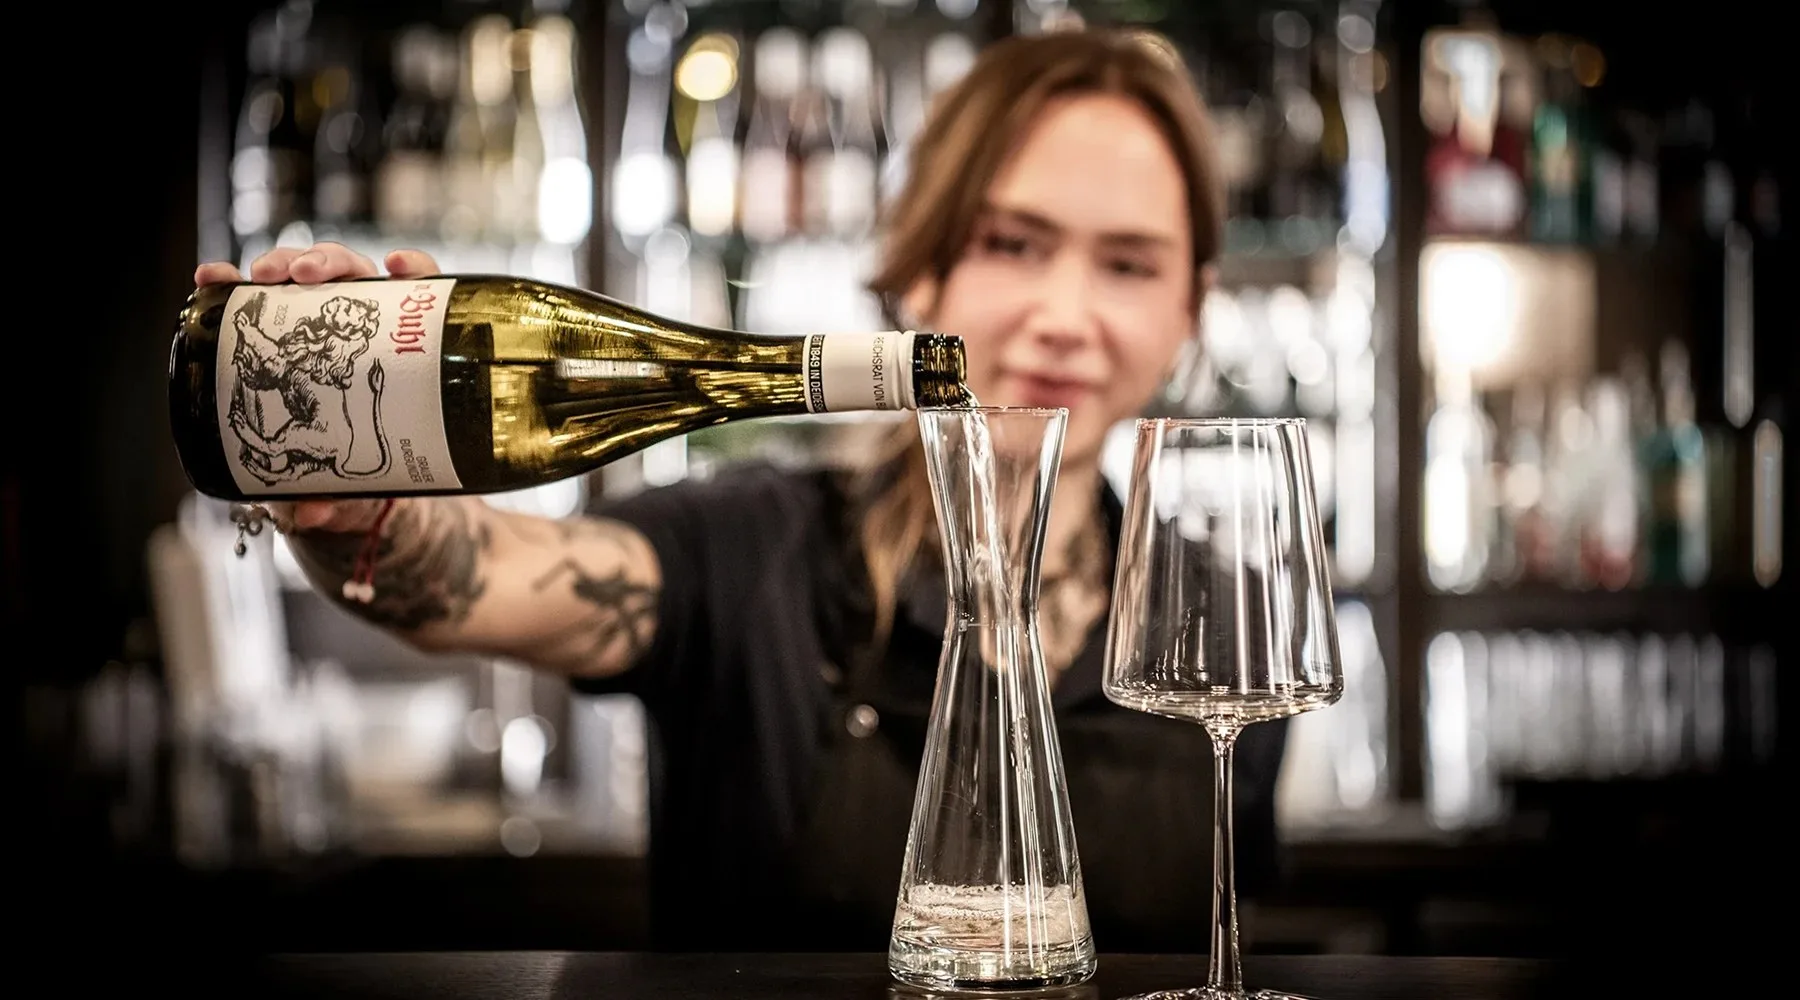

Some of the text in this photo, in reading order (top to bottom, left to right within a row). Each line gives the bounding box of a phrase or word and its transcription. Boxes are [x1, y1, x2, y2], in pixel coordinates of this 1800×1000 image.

[273, 304, 288, 326] 2023
[390, 293, 437, 355] Buhl
[810, 346, 821, 367] 1849
[872, 336, 885, 382] REICHSRAT
[810, 369, 820, 379] IN
[873, 383, 885, 402] VON
[400, 438, 423, 483] BURGUNDER
[416, 456, 435, 483] GRAUER
